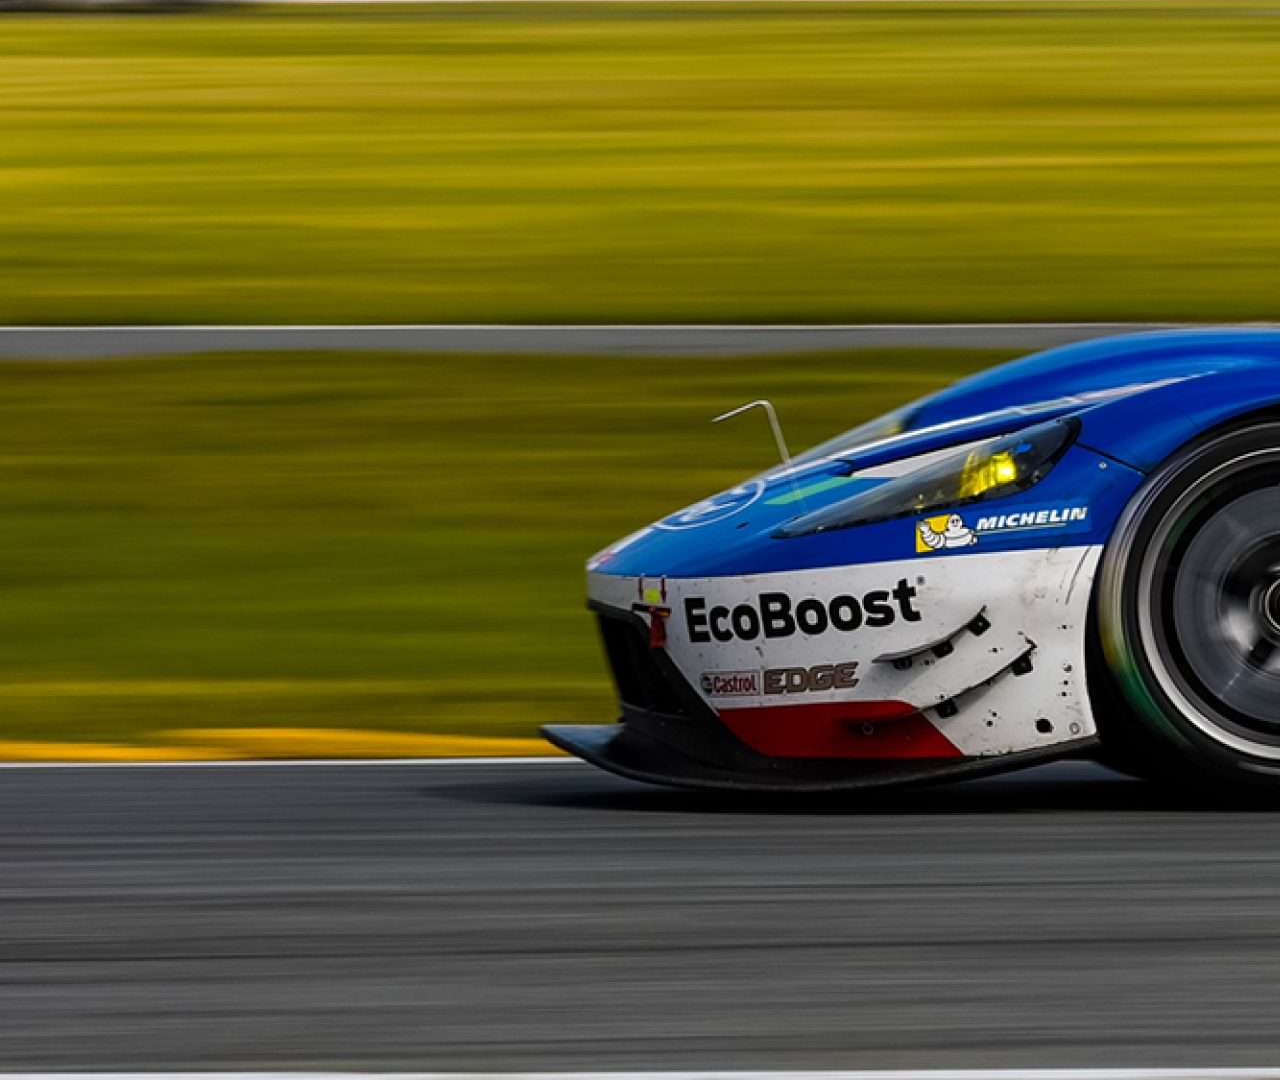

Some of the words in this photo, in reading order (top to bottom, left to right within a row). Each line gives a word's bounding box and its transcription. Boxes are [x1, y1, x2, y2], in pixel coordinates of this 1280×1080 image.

[976, 507, 1088, 530] MICHELIN
[684, 578, 922, 643] EcoBoost
[712, 675, 757, 693] Castrol
[764, 662, 860, 695] EDGE
